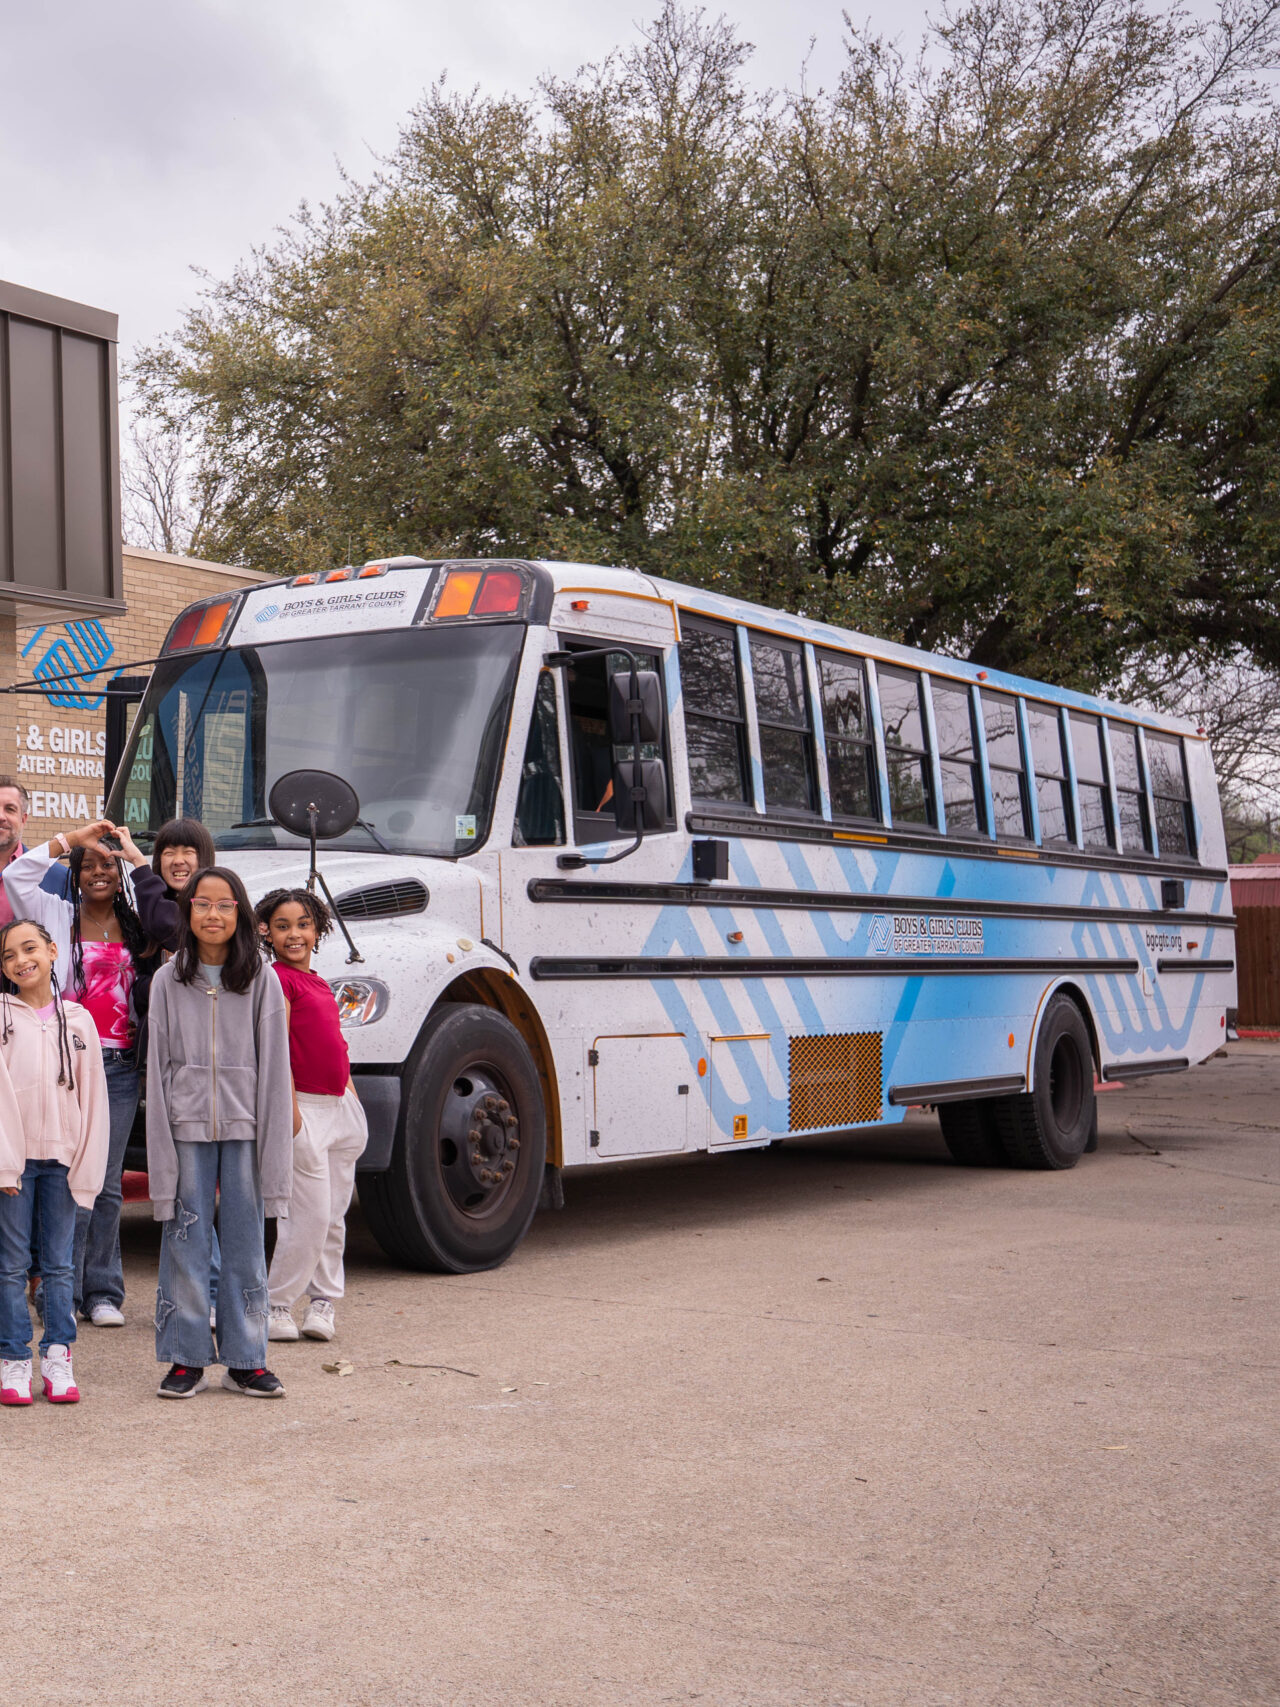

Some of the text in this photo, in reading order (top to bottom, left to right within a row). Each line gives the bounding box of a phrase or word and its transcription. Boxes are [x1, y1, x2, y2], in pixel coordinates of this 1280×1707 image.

[278, 600, 403, 619] OF GREATER TARRANT COUNTY
[283, 590, 406, 611] BOYS & GIRLS CLUBS
[26, 725, 44, 751] &
[49, 727, 106, 756] GIRLS
[17, 754, 55, 775] ATER
[893, 917, 983, 937] BOYS & GIRLS CLUBS
[893, 939, 984, 953] OF GREATER TARRANT COUNTY
[1145, 930, 1182, 952] bgcgtc.org
